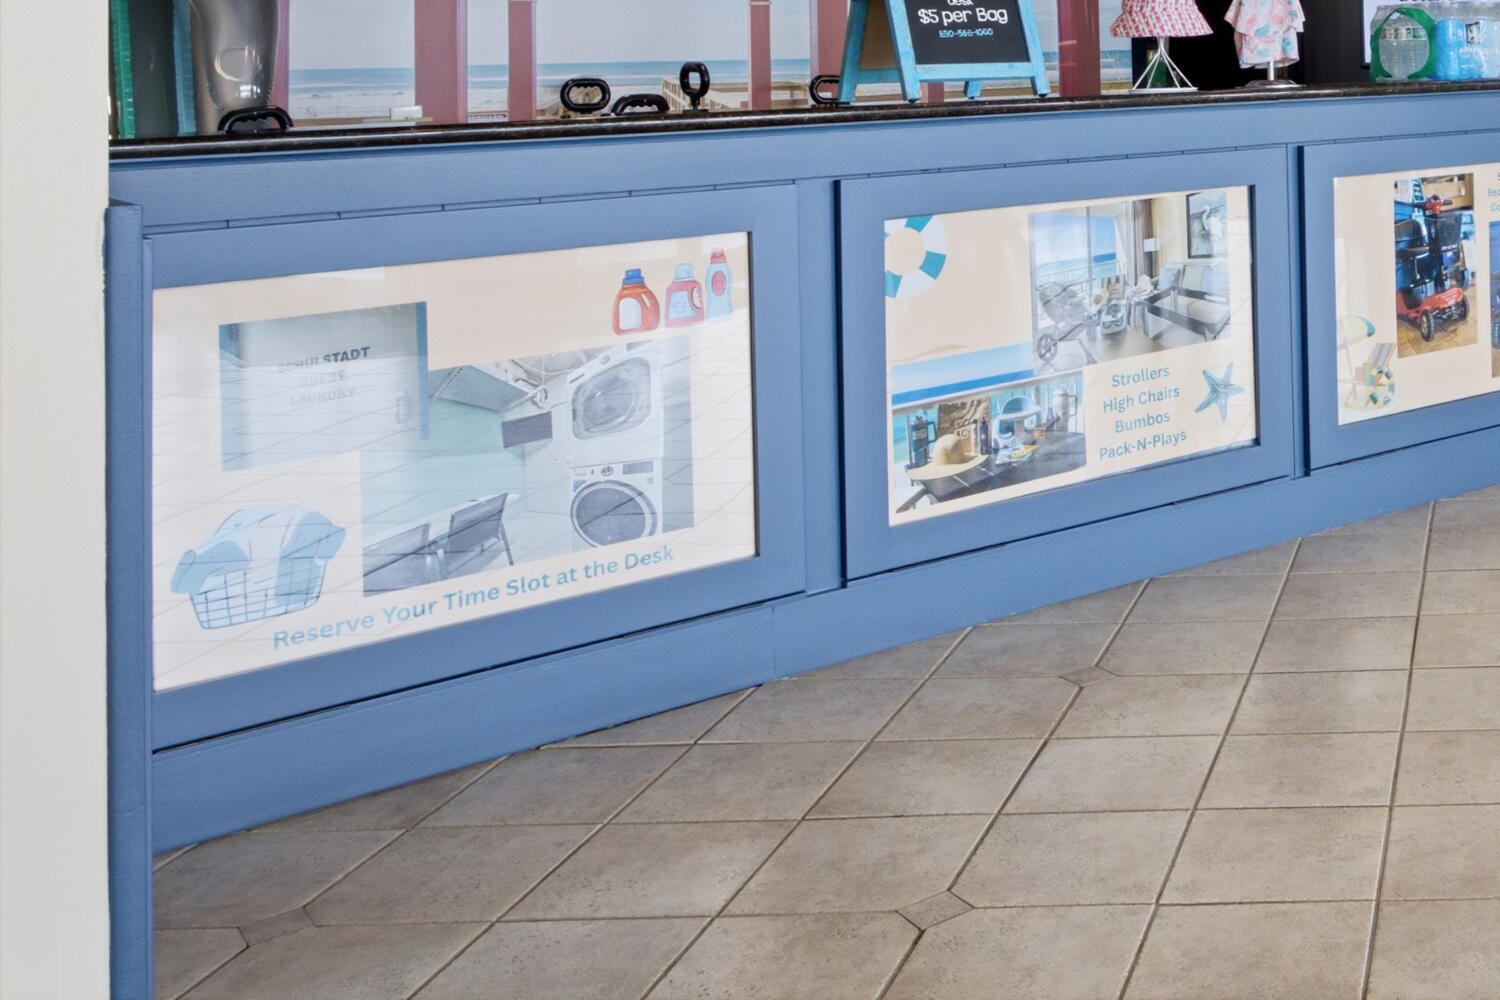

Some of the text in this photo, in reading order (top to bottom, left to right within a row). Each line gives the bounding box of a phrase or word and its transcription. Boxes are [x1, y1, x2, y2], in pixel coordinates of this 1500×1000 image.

[918, 7, 1009, 26] $5 per Bag
[1111, 367, 1170, 388] Strollers
[1103, 386, 1181, 413] High Chairs
[1115, 412, 1170, 434] Bumbos
[1099, 431, 1188, 461] Pack-N-Plays
[273, 544, 674, 651] Reserve Your Time Slot at the Desk
